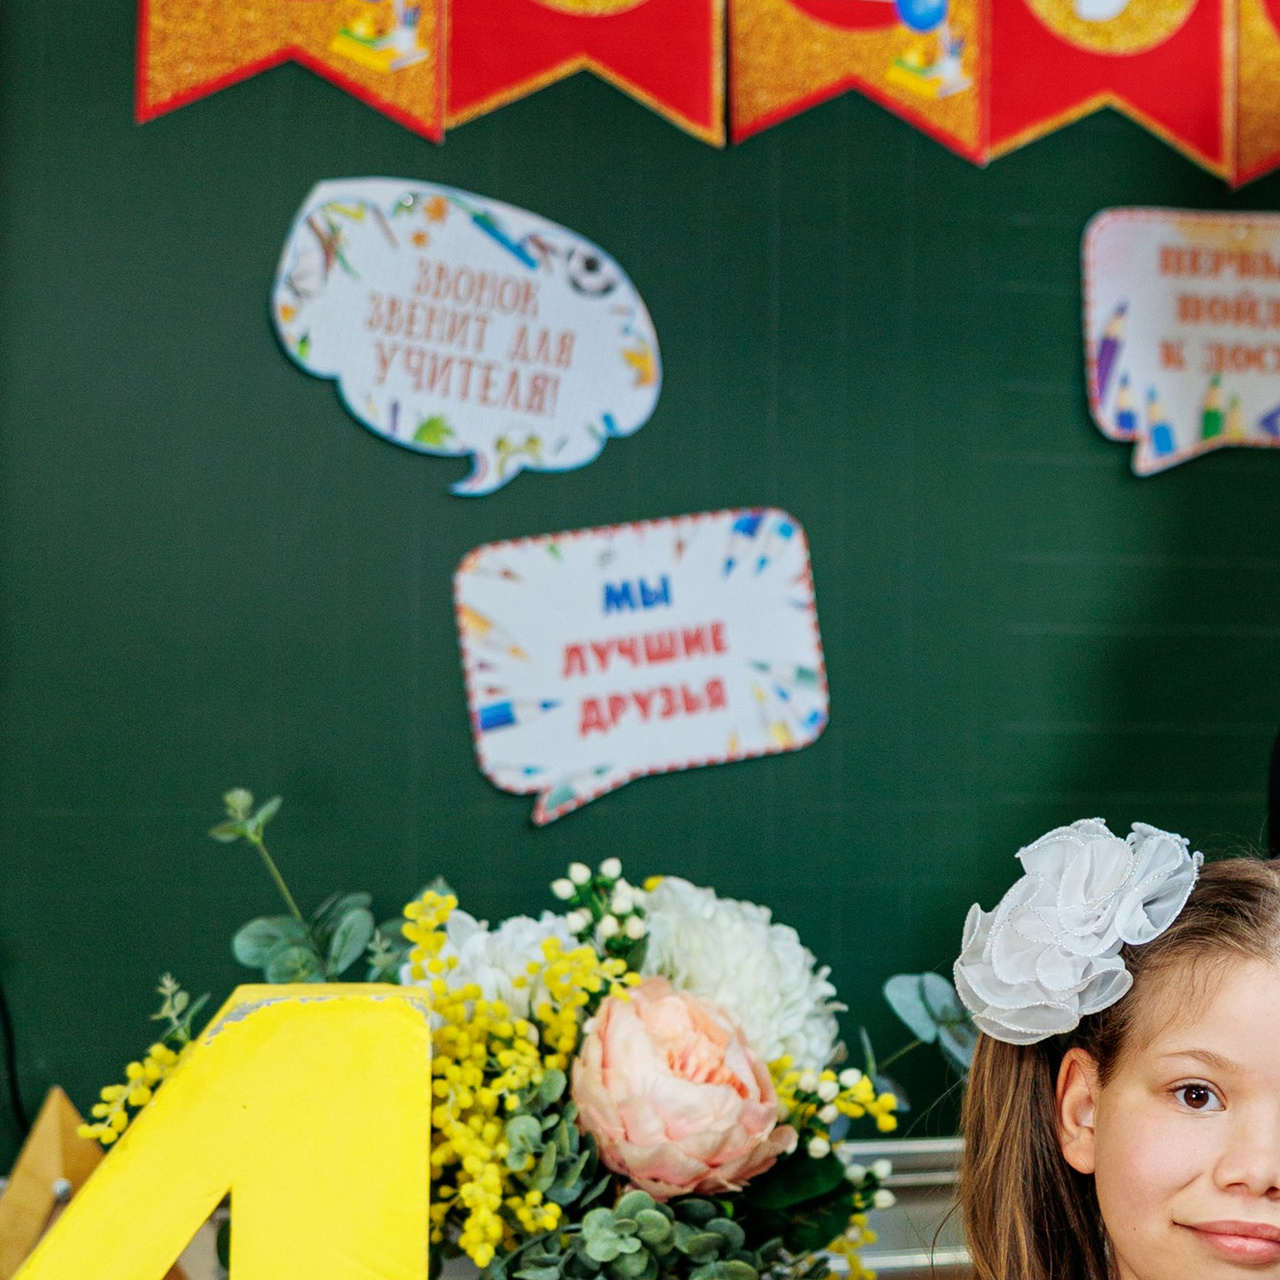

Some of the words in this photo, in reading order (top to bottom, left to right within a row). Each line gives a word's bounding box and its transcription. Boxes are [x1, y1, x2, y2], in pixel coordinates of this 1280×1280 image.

[415, 257, 540, 318] ЗВОНОК
[365, 291, 490, 352] ЗВЕНИТ
[510, 324, 576, 369] ДЛЯ
[1159, 340, 1185, 370] К
[373, 340, 562, 417] УЧИТЕЛЯ!
[603, 575, 672, 613] МЫ
[562, 621, 727, 679] ЛУЧШИЕ
[579, 676, 727, 737] ДРУЗЬЯ
